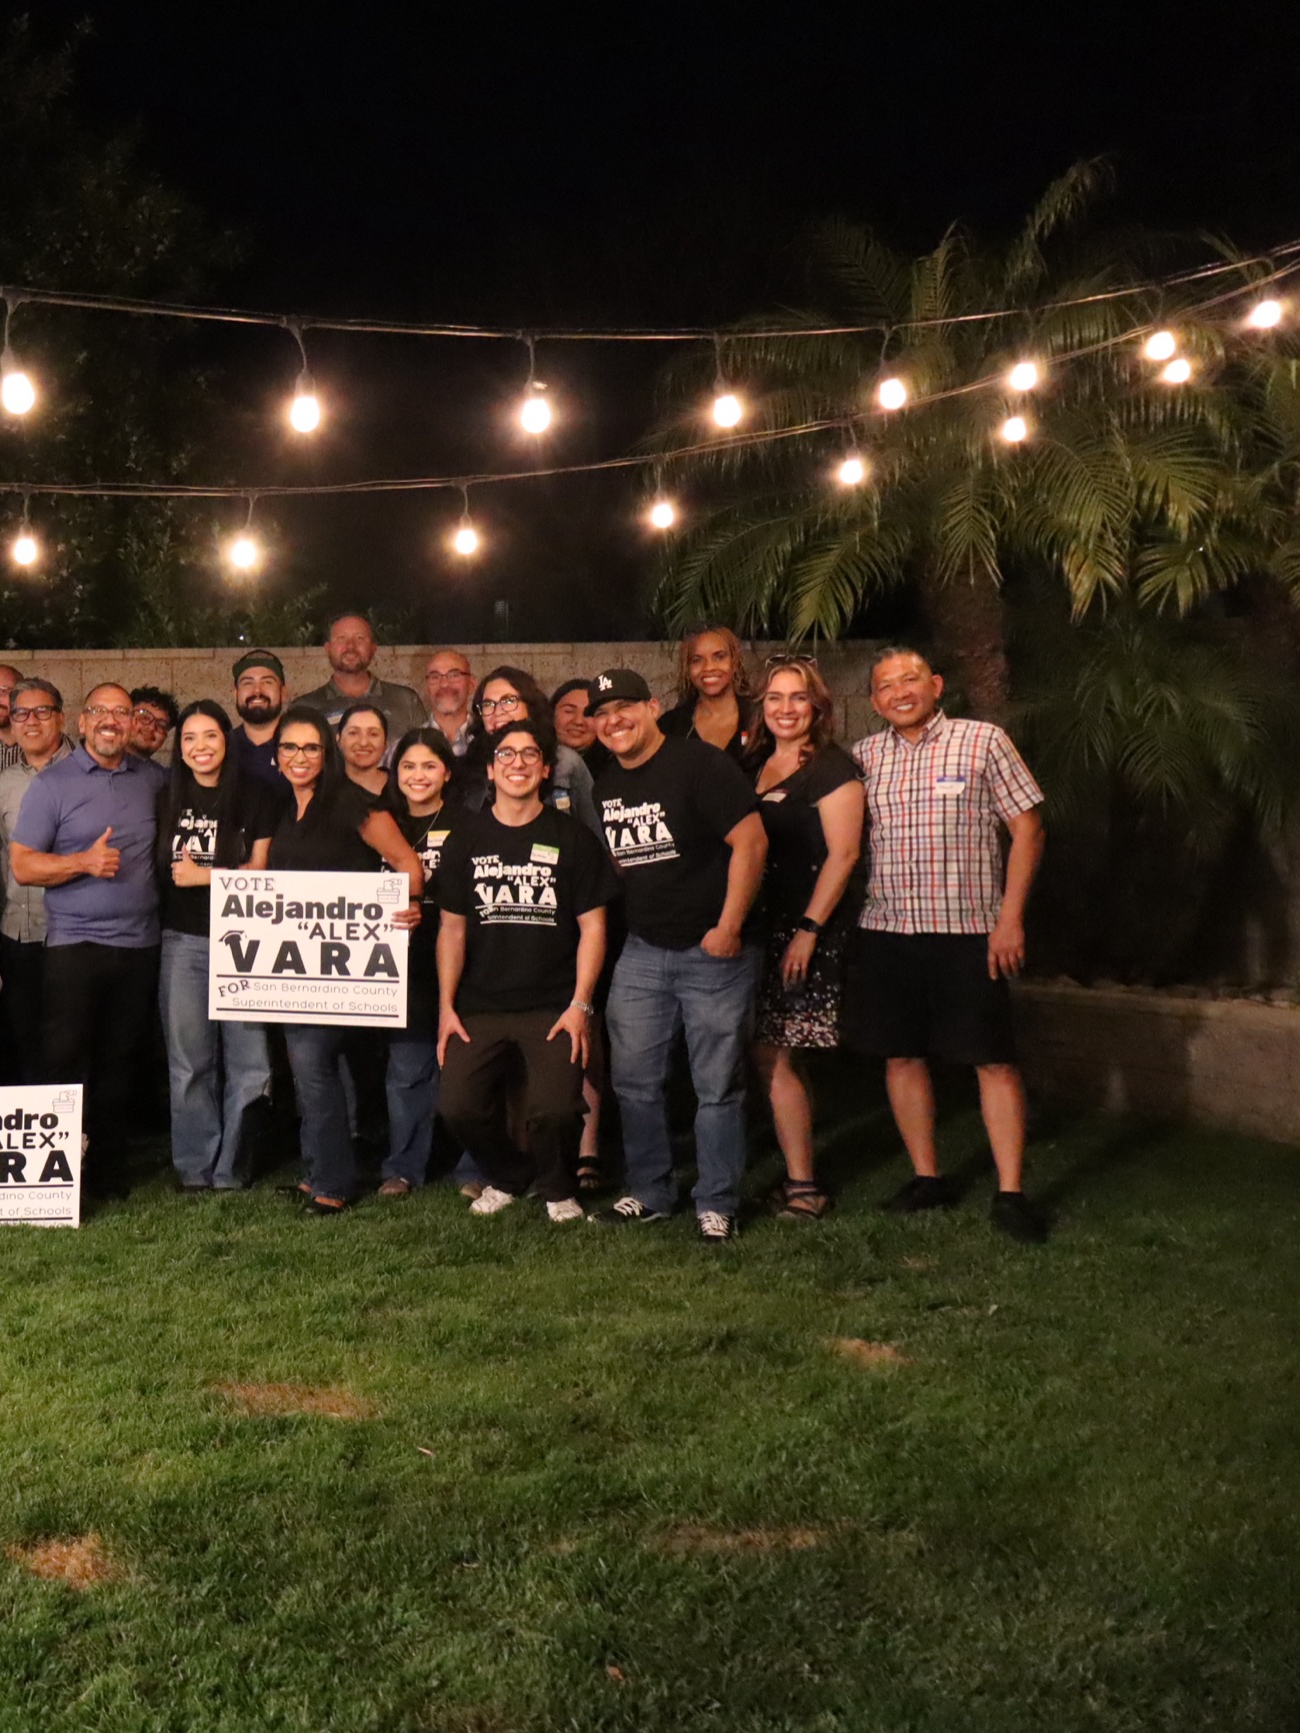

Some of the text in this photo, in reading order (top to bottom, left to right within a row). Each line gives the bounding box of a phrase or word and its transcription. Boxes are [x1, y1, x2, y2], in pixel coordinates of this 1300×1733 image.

[598, 674, 613, 691] LA
[602, 798, 622, 808] VOTE
[603, 802, 661, 822] Alejandro
[605, 821, 674, 848] VARA
[471, 855, 499, 865] VOTE
[473, 862, 552, 879] Alejandro
[219, 877, 275, 891] VOTE
[474, 883, 557, 905] VARA
[221, 894, 383, 924] Alejandro
[219, 930, 399, 978] VARA
[218, 979, 398, 997] FOR San Bernardino County
[232, 997, 398, 1013] Superintendent of Schools
[28, 1190, 72, 1201] County
[7, 1206, 20, 1216] of
[23, 1206, 72, 1216] Schools
